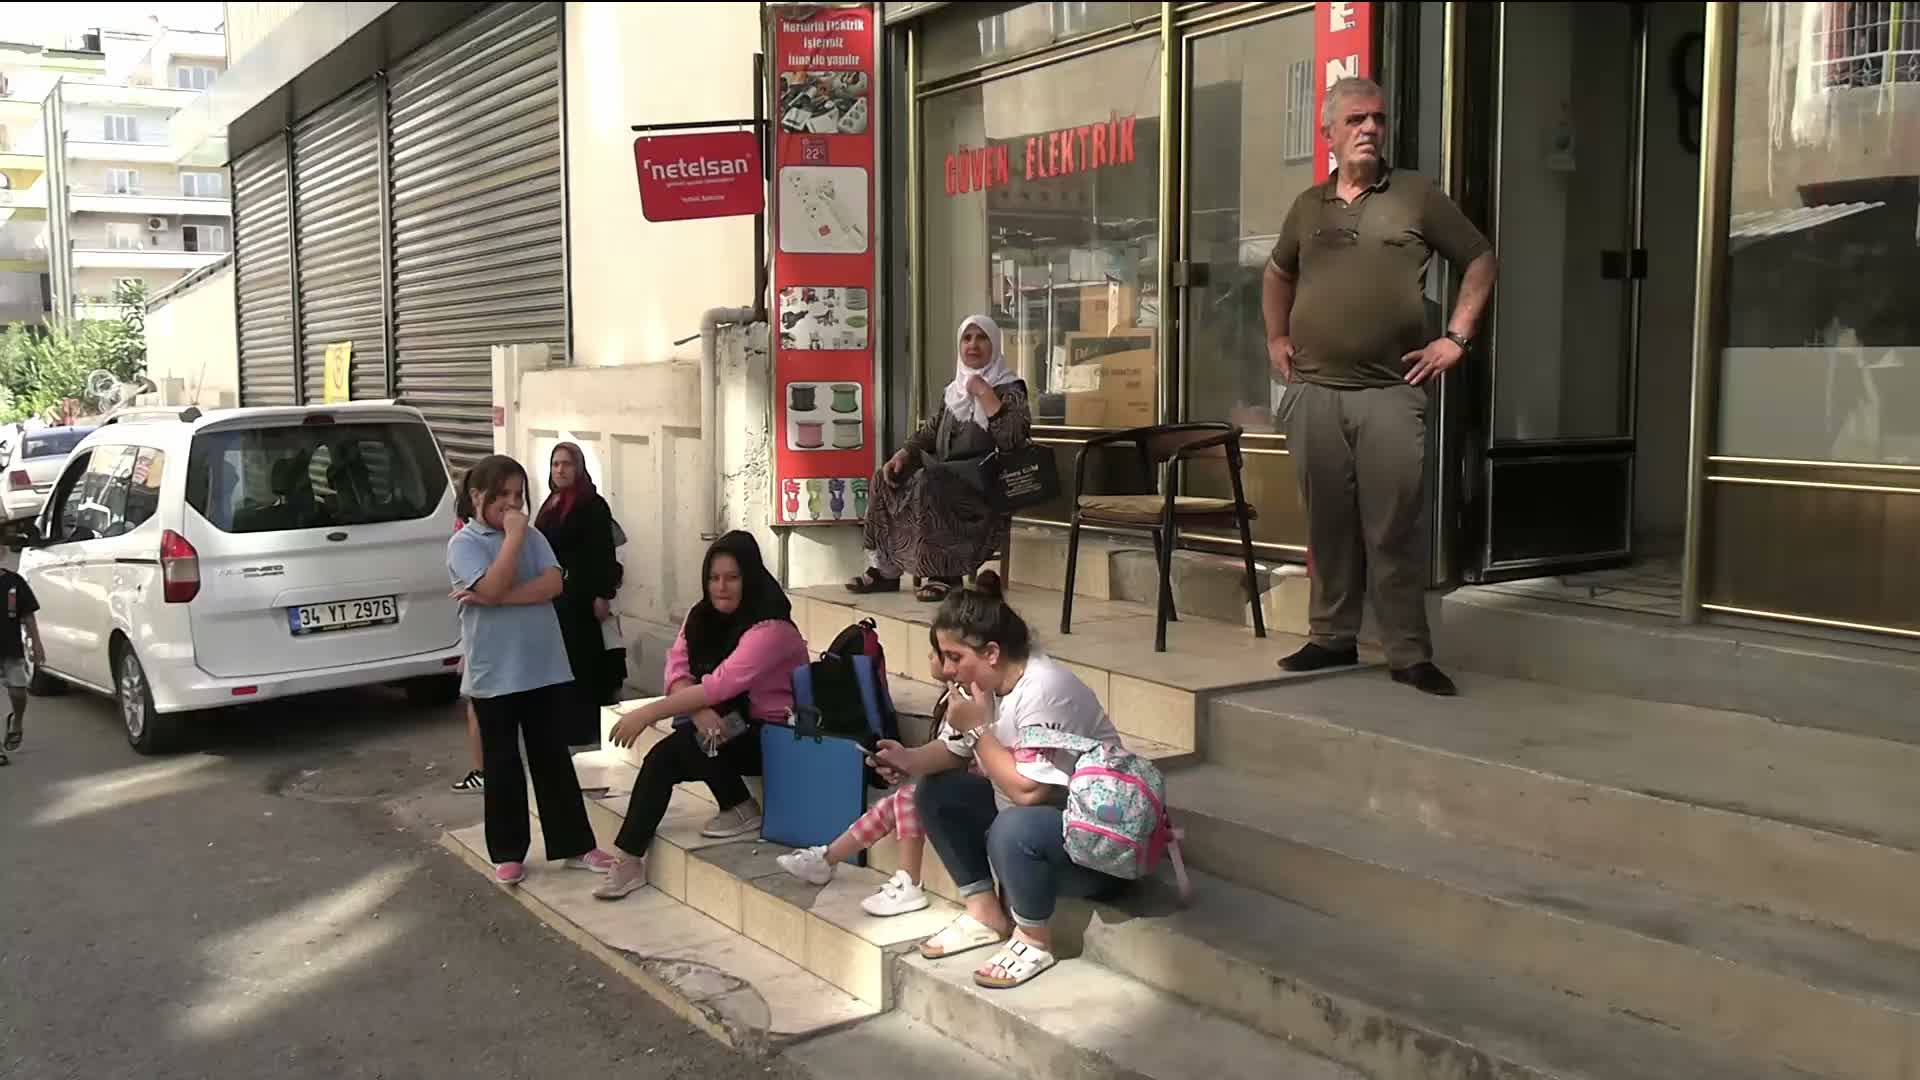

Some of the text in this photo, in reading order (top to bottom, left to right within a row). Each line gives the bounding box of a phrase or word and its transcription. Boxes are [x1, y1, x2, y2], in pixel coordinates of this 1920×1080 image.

[943, 110, 1137, 197] GÜVEN ELEKTRİK
[650, 156, 749, 181] netelsan
[299, 608, 321, 627] 34
[328, 604, 347, 622] YT
[353, 599, 392, 620] 2976
